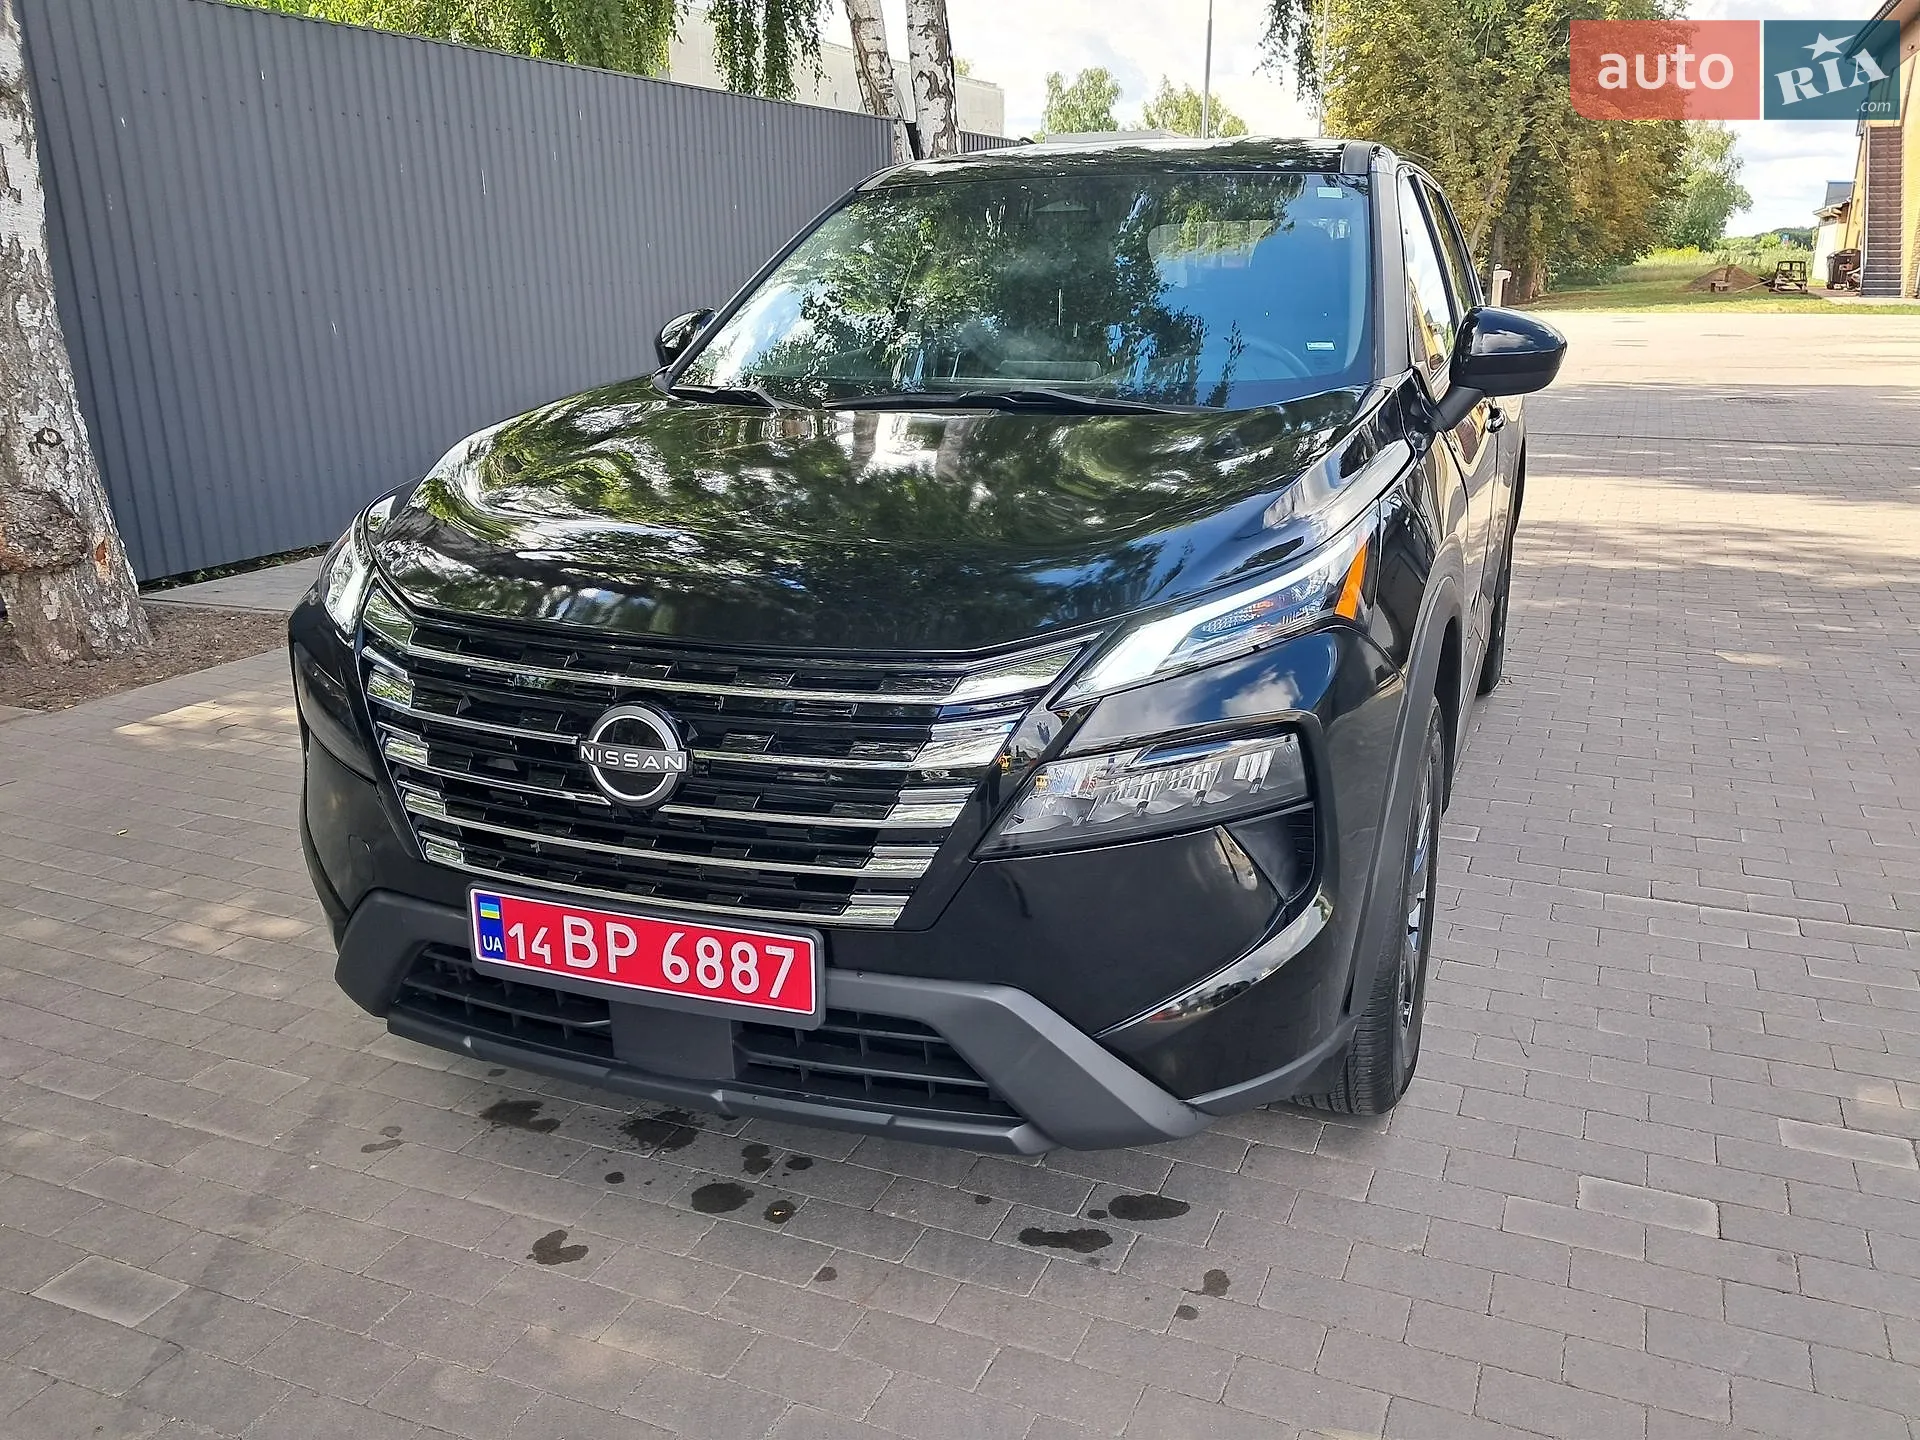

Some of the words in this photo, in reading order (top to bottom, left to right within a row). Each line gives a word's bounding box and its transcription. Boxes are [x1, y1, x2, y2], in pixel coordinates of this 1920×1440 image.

[580, 745, 683, 770] NISSAN
[483, 934, 503, 953] UA
[661, 932, 795, 999] 6887
